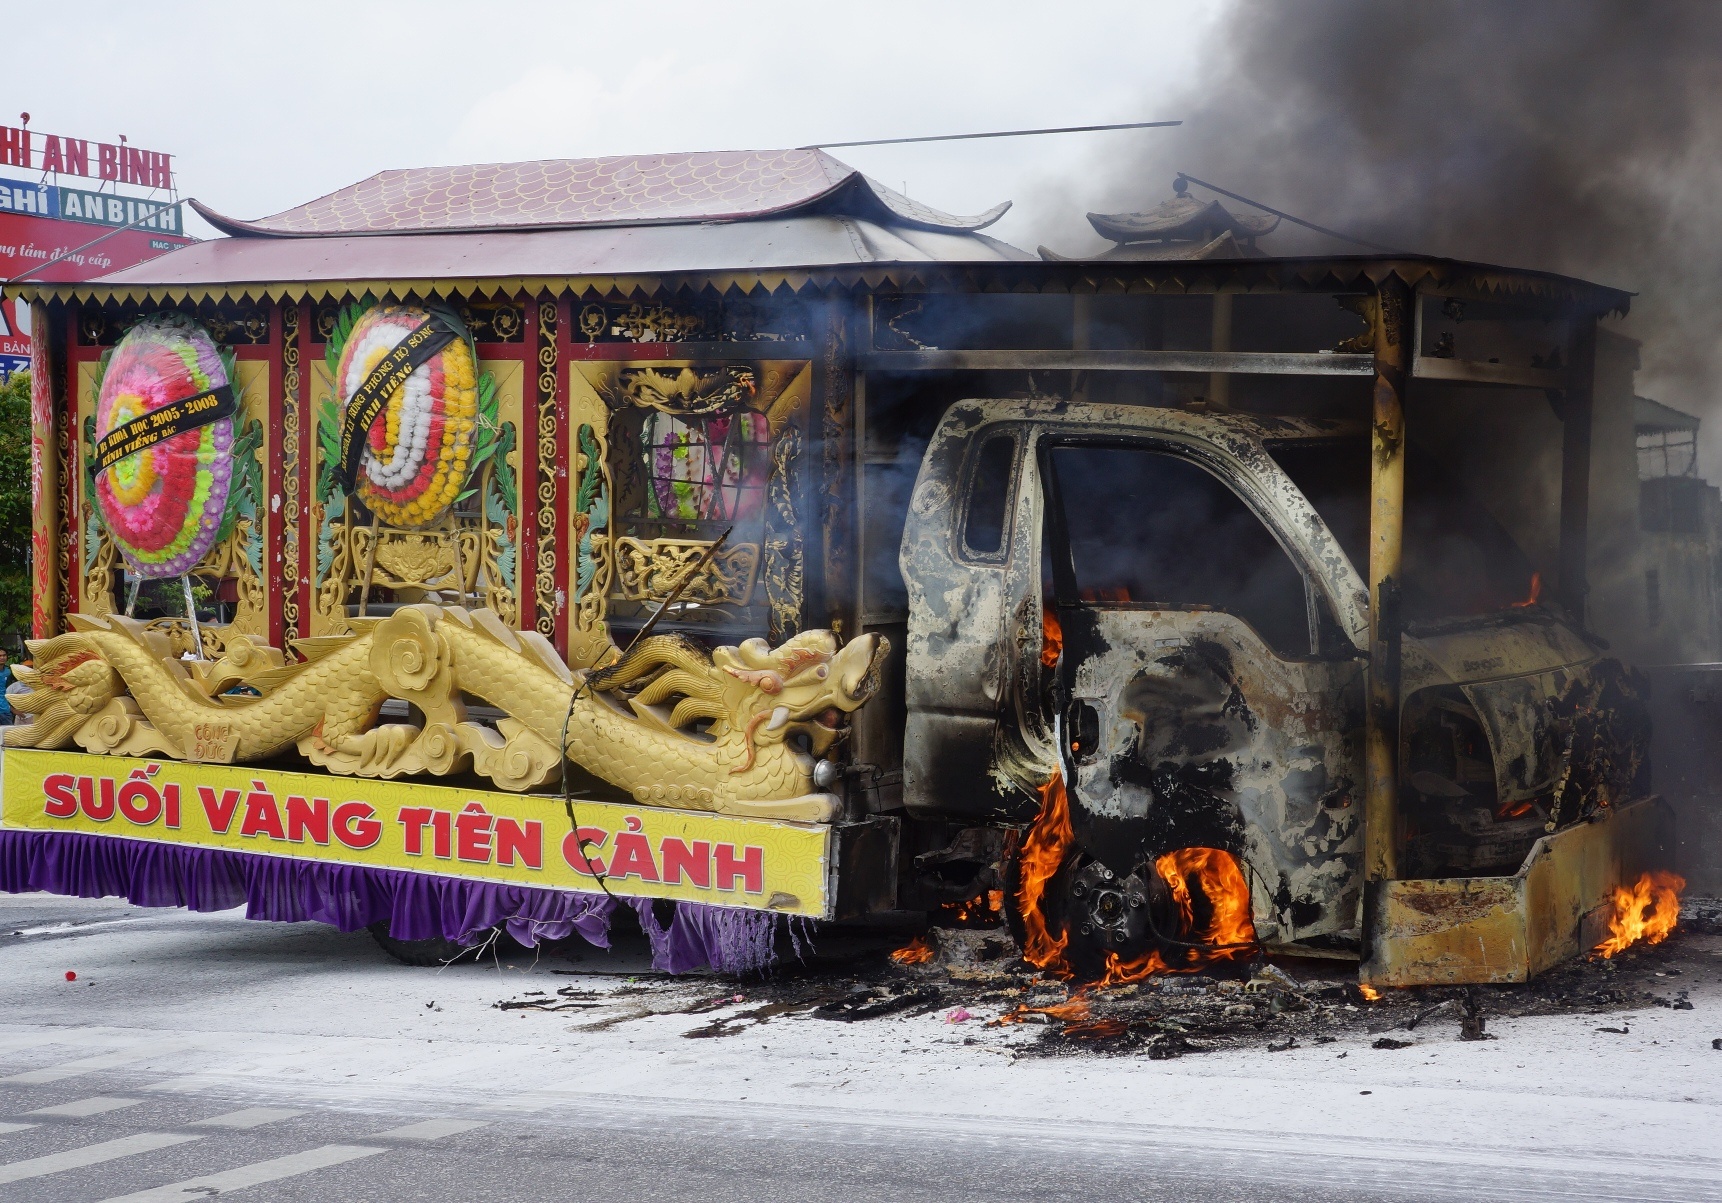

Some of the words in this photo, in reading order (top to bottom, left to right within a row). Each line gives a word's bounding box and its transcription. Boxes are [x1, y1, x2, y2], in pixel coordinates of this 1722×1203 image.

[42, 134, 89, 177] AN
[99, 134, 171, 189] BÌNH
[20, 243, 47, 259] tầm
[88, 252, 112, 269] cấp
[363, 360, 394, 395] PHÒNG
[393, 346, 410, 362] HỘ
[360, 398, 381, 432] KÍNH
[380, 362, 413, 399] VIẾNG
[102, 449, 123, 467] KÍNH
[125, 431, 158, 454] VIẾNG
[161, 425, 177, 438] BÁC
[130, 418, 150, 436] HỌC
[194, 740, 226, 760] ĐỨC
[195, 723, 228, 743] CÔNG
[43, 764, 181, 829] SUỐI
[197, 780, 383, 850] VÀNG
[397, 802, 543, 870] TIÊN
[562, 816, 764, 894] CẢNH
